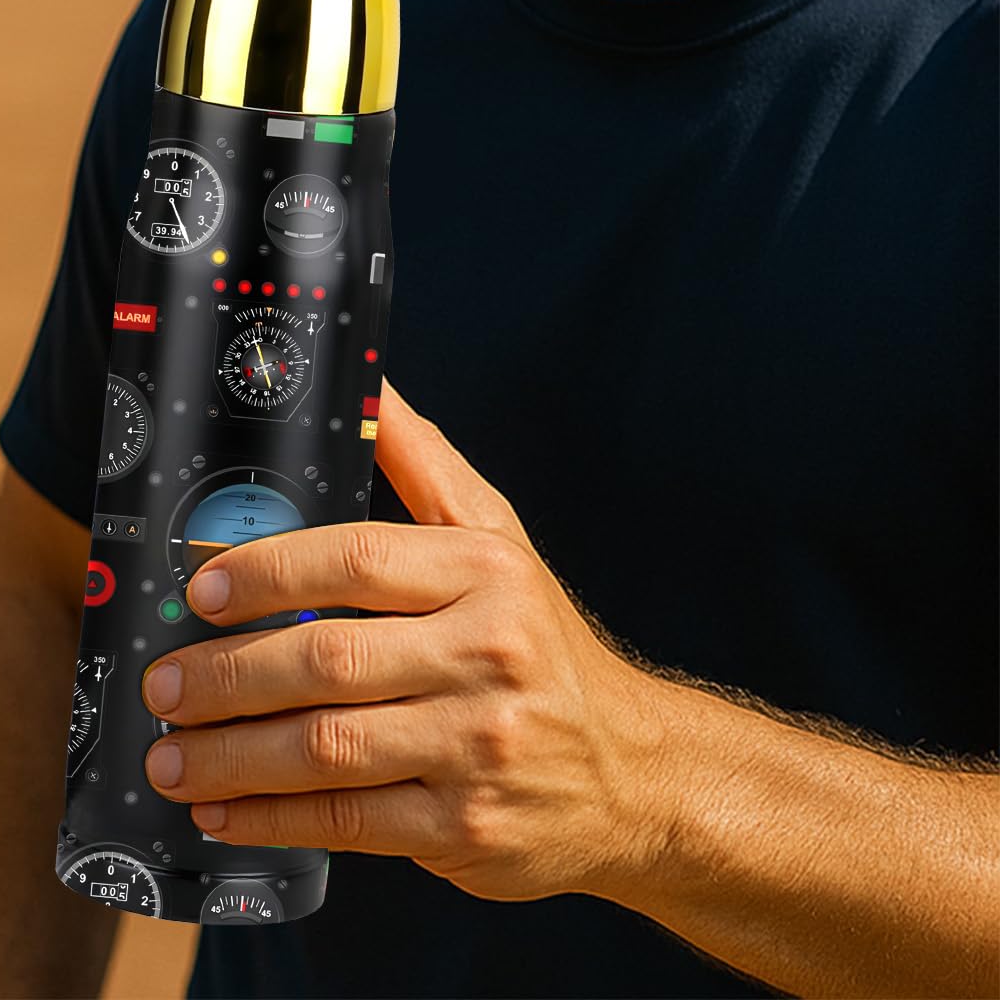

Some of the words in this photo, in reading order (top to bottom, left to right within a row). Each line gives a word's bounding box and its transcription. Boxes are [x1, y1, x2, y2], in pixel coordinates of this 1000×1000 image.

[172, 160, 178, 171] 0
[143, 168, 150, 180] 9
[194, 170, 200, 180] 1
[205, 192, 212, 202] 2
[134, 211, 142, 222] 7
[198, 215, 204, 226] 3
[114, 312, 150, 324] ALARM
[245, 494, 256, 502] 20
[242, 516, 254, 526] 10
[108, 864, 114, 876] 0
[80, 873, 86, 884] 9
[130, 874, 136, 884] 1
[141, 896, 148, 906] 2
[261, 910, 272, 918] 45
